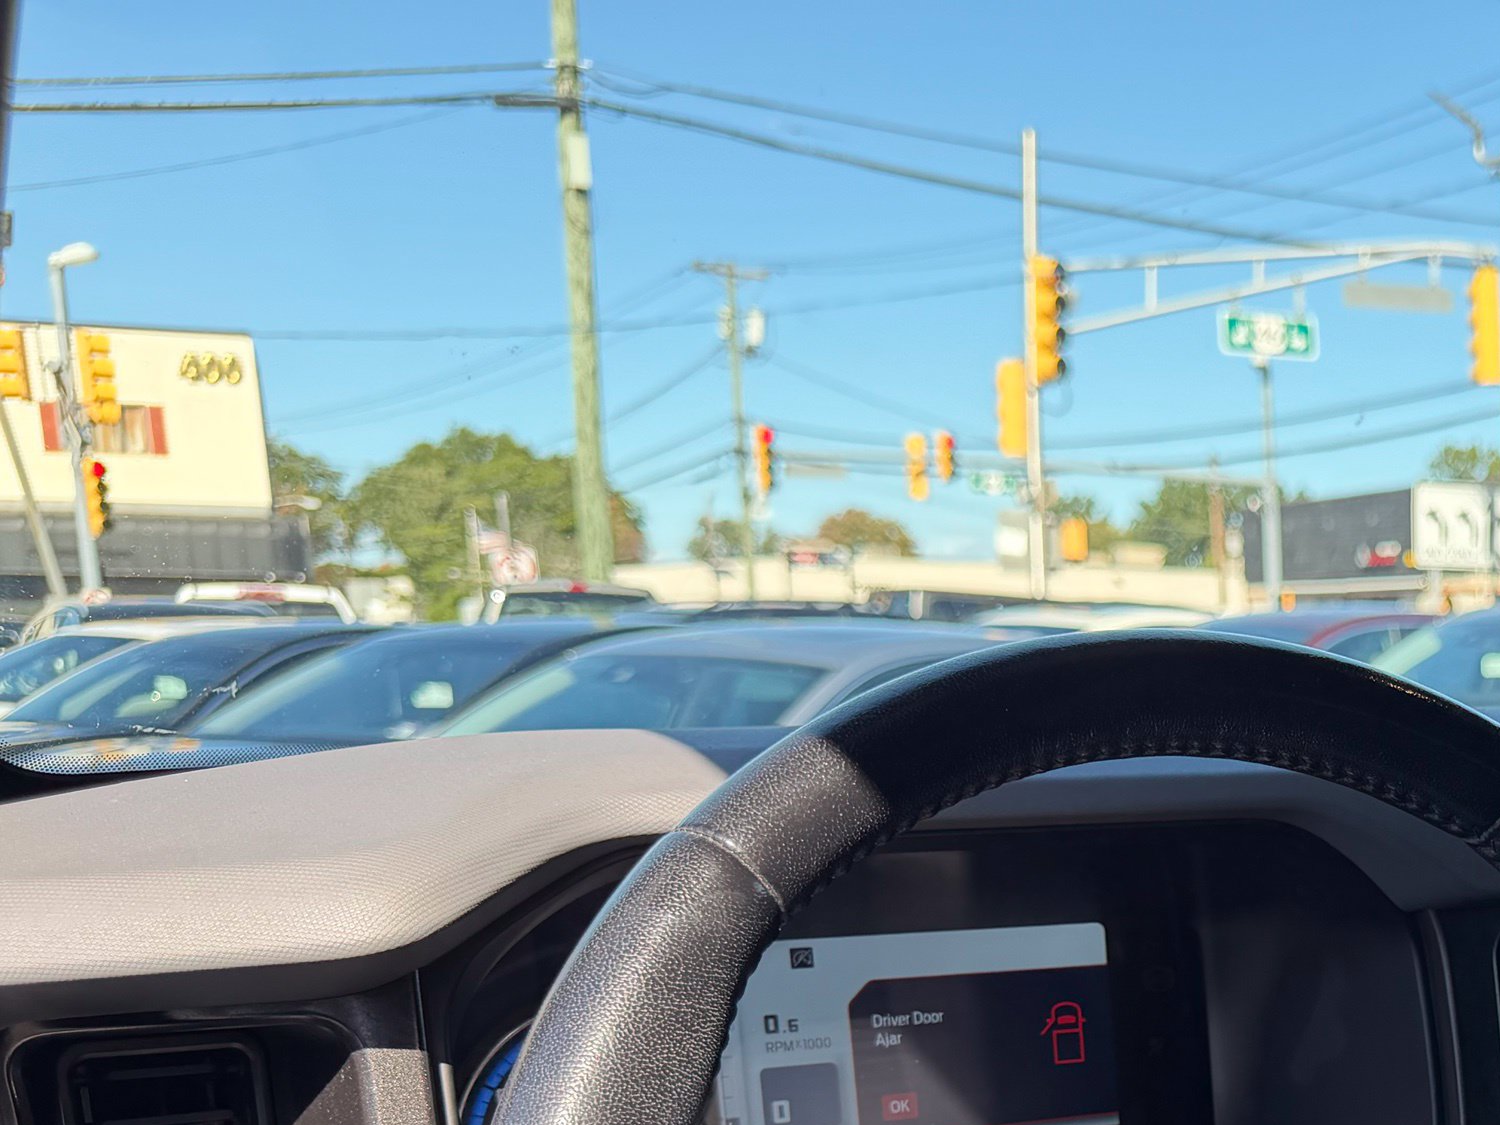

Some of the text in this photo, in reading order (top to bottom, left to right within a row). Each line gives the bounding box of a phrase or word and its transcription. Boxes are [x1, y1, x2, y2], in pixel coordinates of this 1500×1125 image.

[872, 1010, 944, 1029] Driver Door
[875, 1032, 903, 1048] Ajar
[772, 1099, 791, 1124] 0
[890, 1099, 910, 1114] OK
